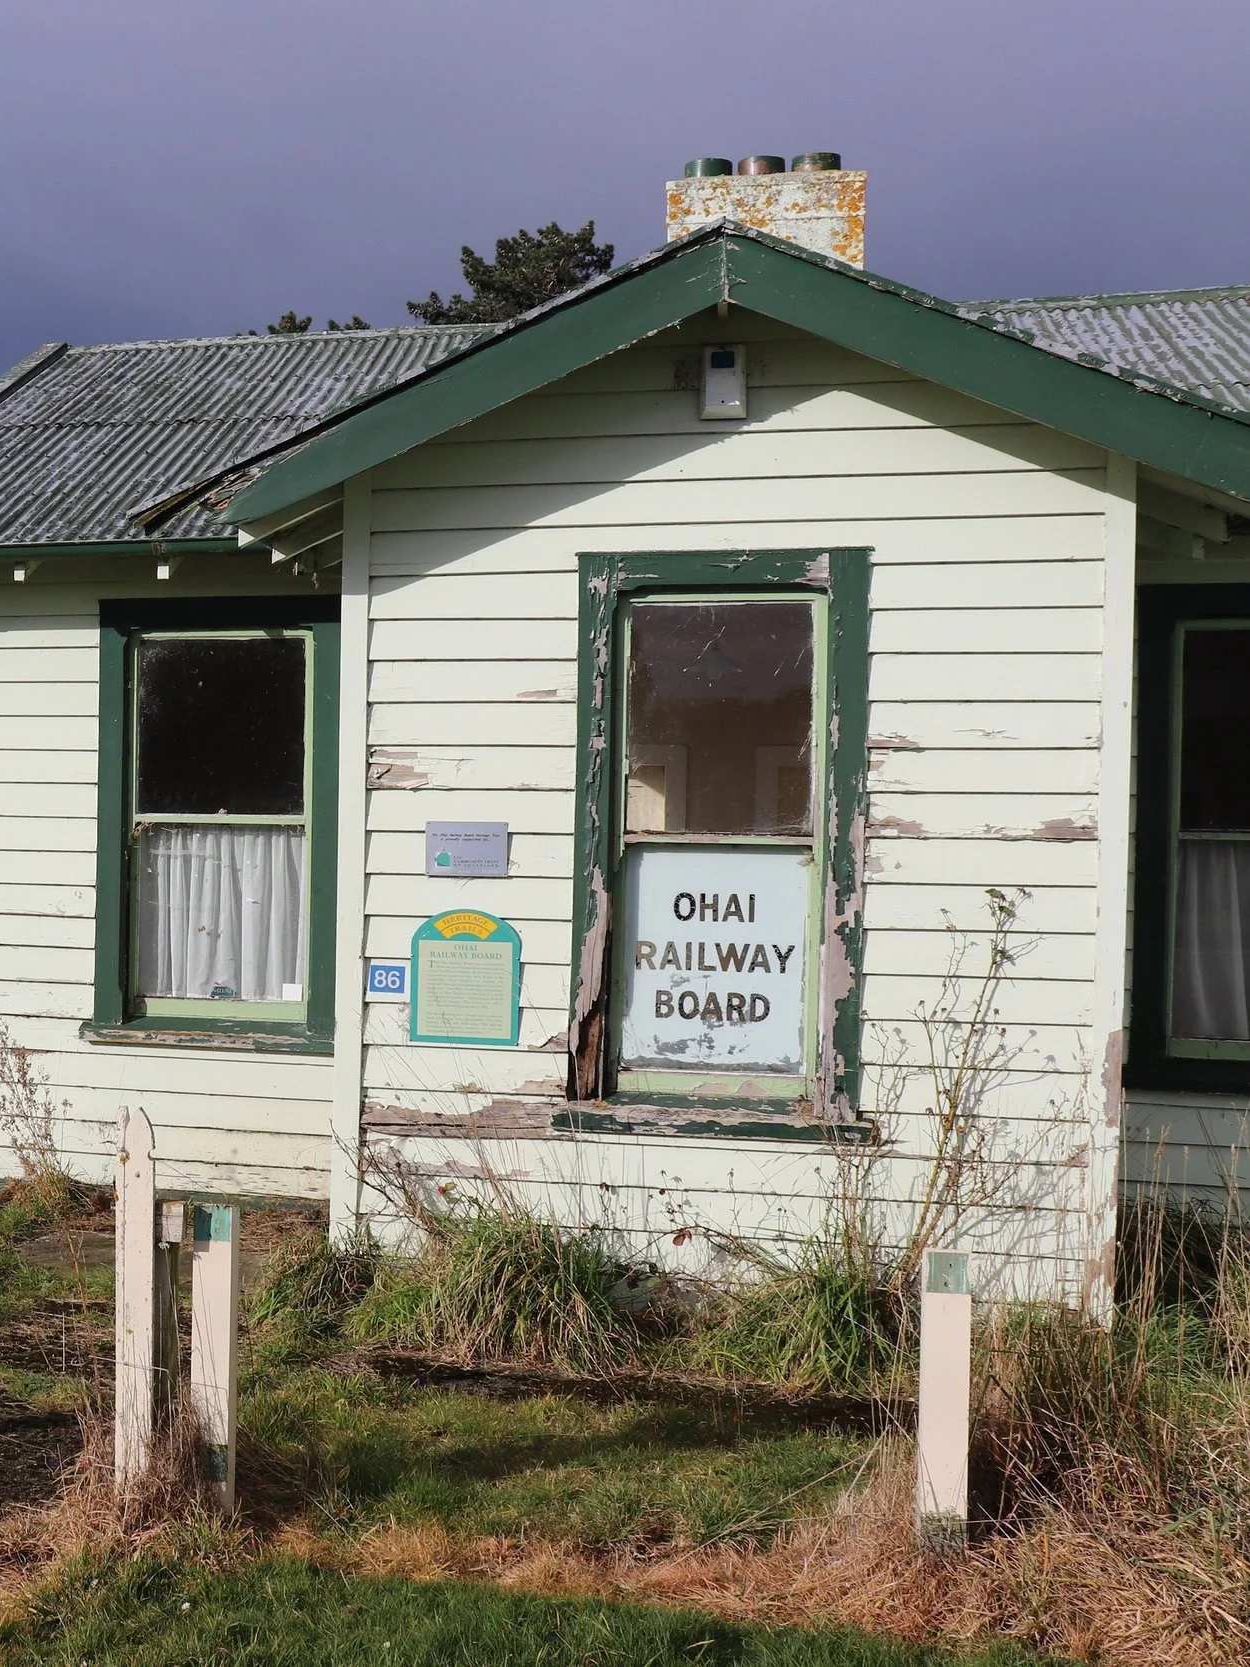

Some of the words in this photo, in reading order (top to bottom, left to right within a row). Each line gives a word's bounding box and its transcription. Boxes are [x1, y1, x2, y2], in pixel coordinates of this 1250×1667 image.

[673, 892, 756, 923] OHAI
[442, 914, 488, 926] HERITAGE
[447, 925, 483, 936] TRAILS
[454, 943, 478, 951] OHAI
[430, 951, 470, 959] RAILWAY
[471, 952, 502, 960] BOARD
[635, 940, 796, 974] RAILWAY
[374, 970, 400, 989] 86
[655, 989, 771, 1023] BOARD
